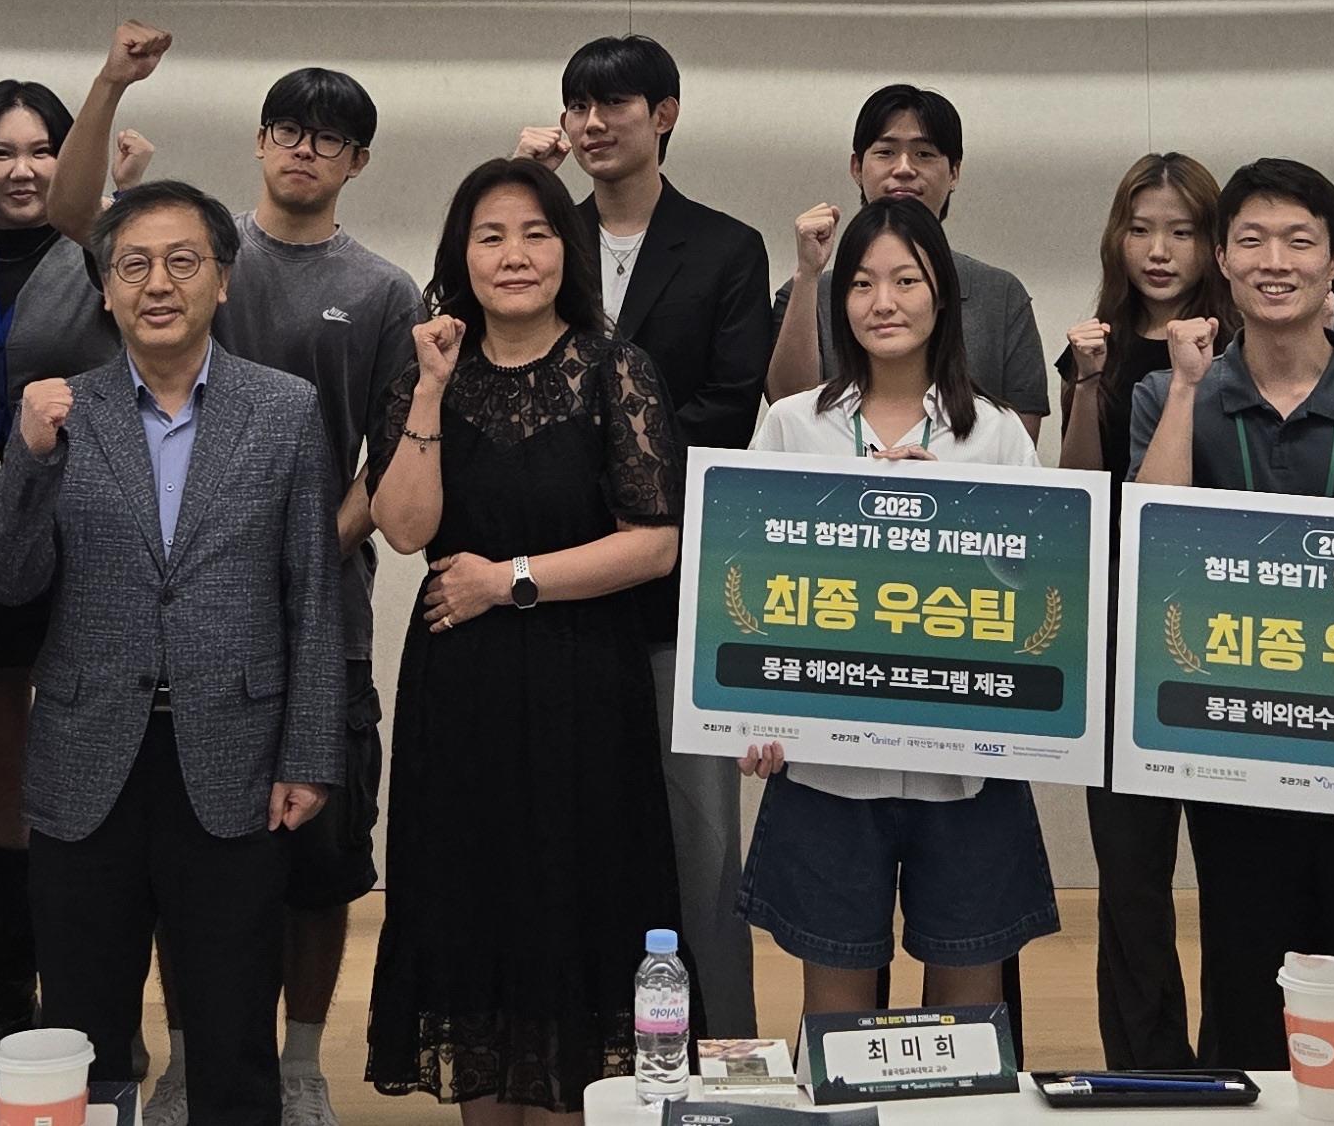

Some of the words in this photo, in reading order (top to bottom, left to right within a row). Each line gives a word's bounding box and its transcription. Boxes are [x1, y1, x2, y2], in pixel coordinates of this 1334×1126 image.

[874, 497, 921, 516] 2025
[765, 519, 807, 545] 청년
[814, 523, 881, 548] 창업가
[888, 527, 930, 552] 양성
[937, 530, 1026, 559] 지원사업
[1205, 557, 1249, 582] 청년
[1257, 561, 1327, 589] 창업가
[763, 575, 859, 629] 최종
[874, 583, 1016, 642] 우승팀
[1206, 613, 1306, 672] 최종
[762, 657, 802, 681] 몽골
[806, 660, 886, 687] 해외연수
[889, 667, 969, 694] 프로그램
[974, 673, 1015, 697] 제공
[1206, 697, 1247, 722] 몽골
[1252, 700, 1334, 730] 해외연수
[871, 736, 901, 746] Unitef
[975, 742, 1005, 753] KAIST
[1280, 776, 1310, 787] 주관기관
[868, 1038, 888, 1063] 최
[901, 1036, 921, 1061] 미
[934, 1034, 955, 1059] 희
